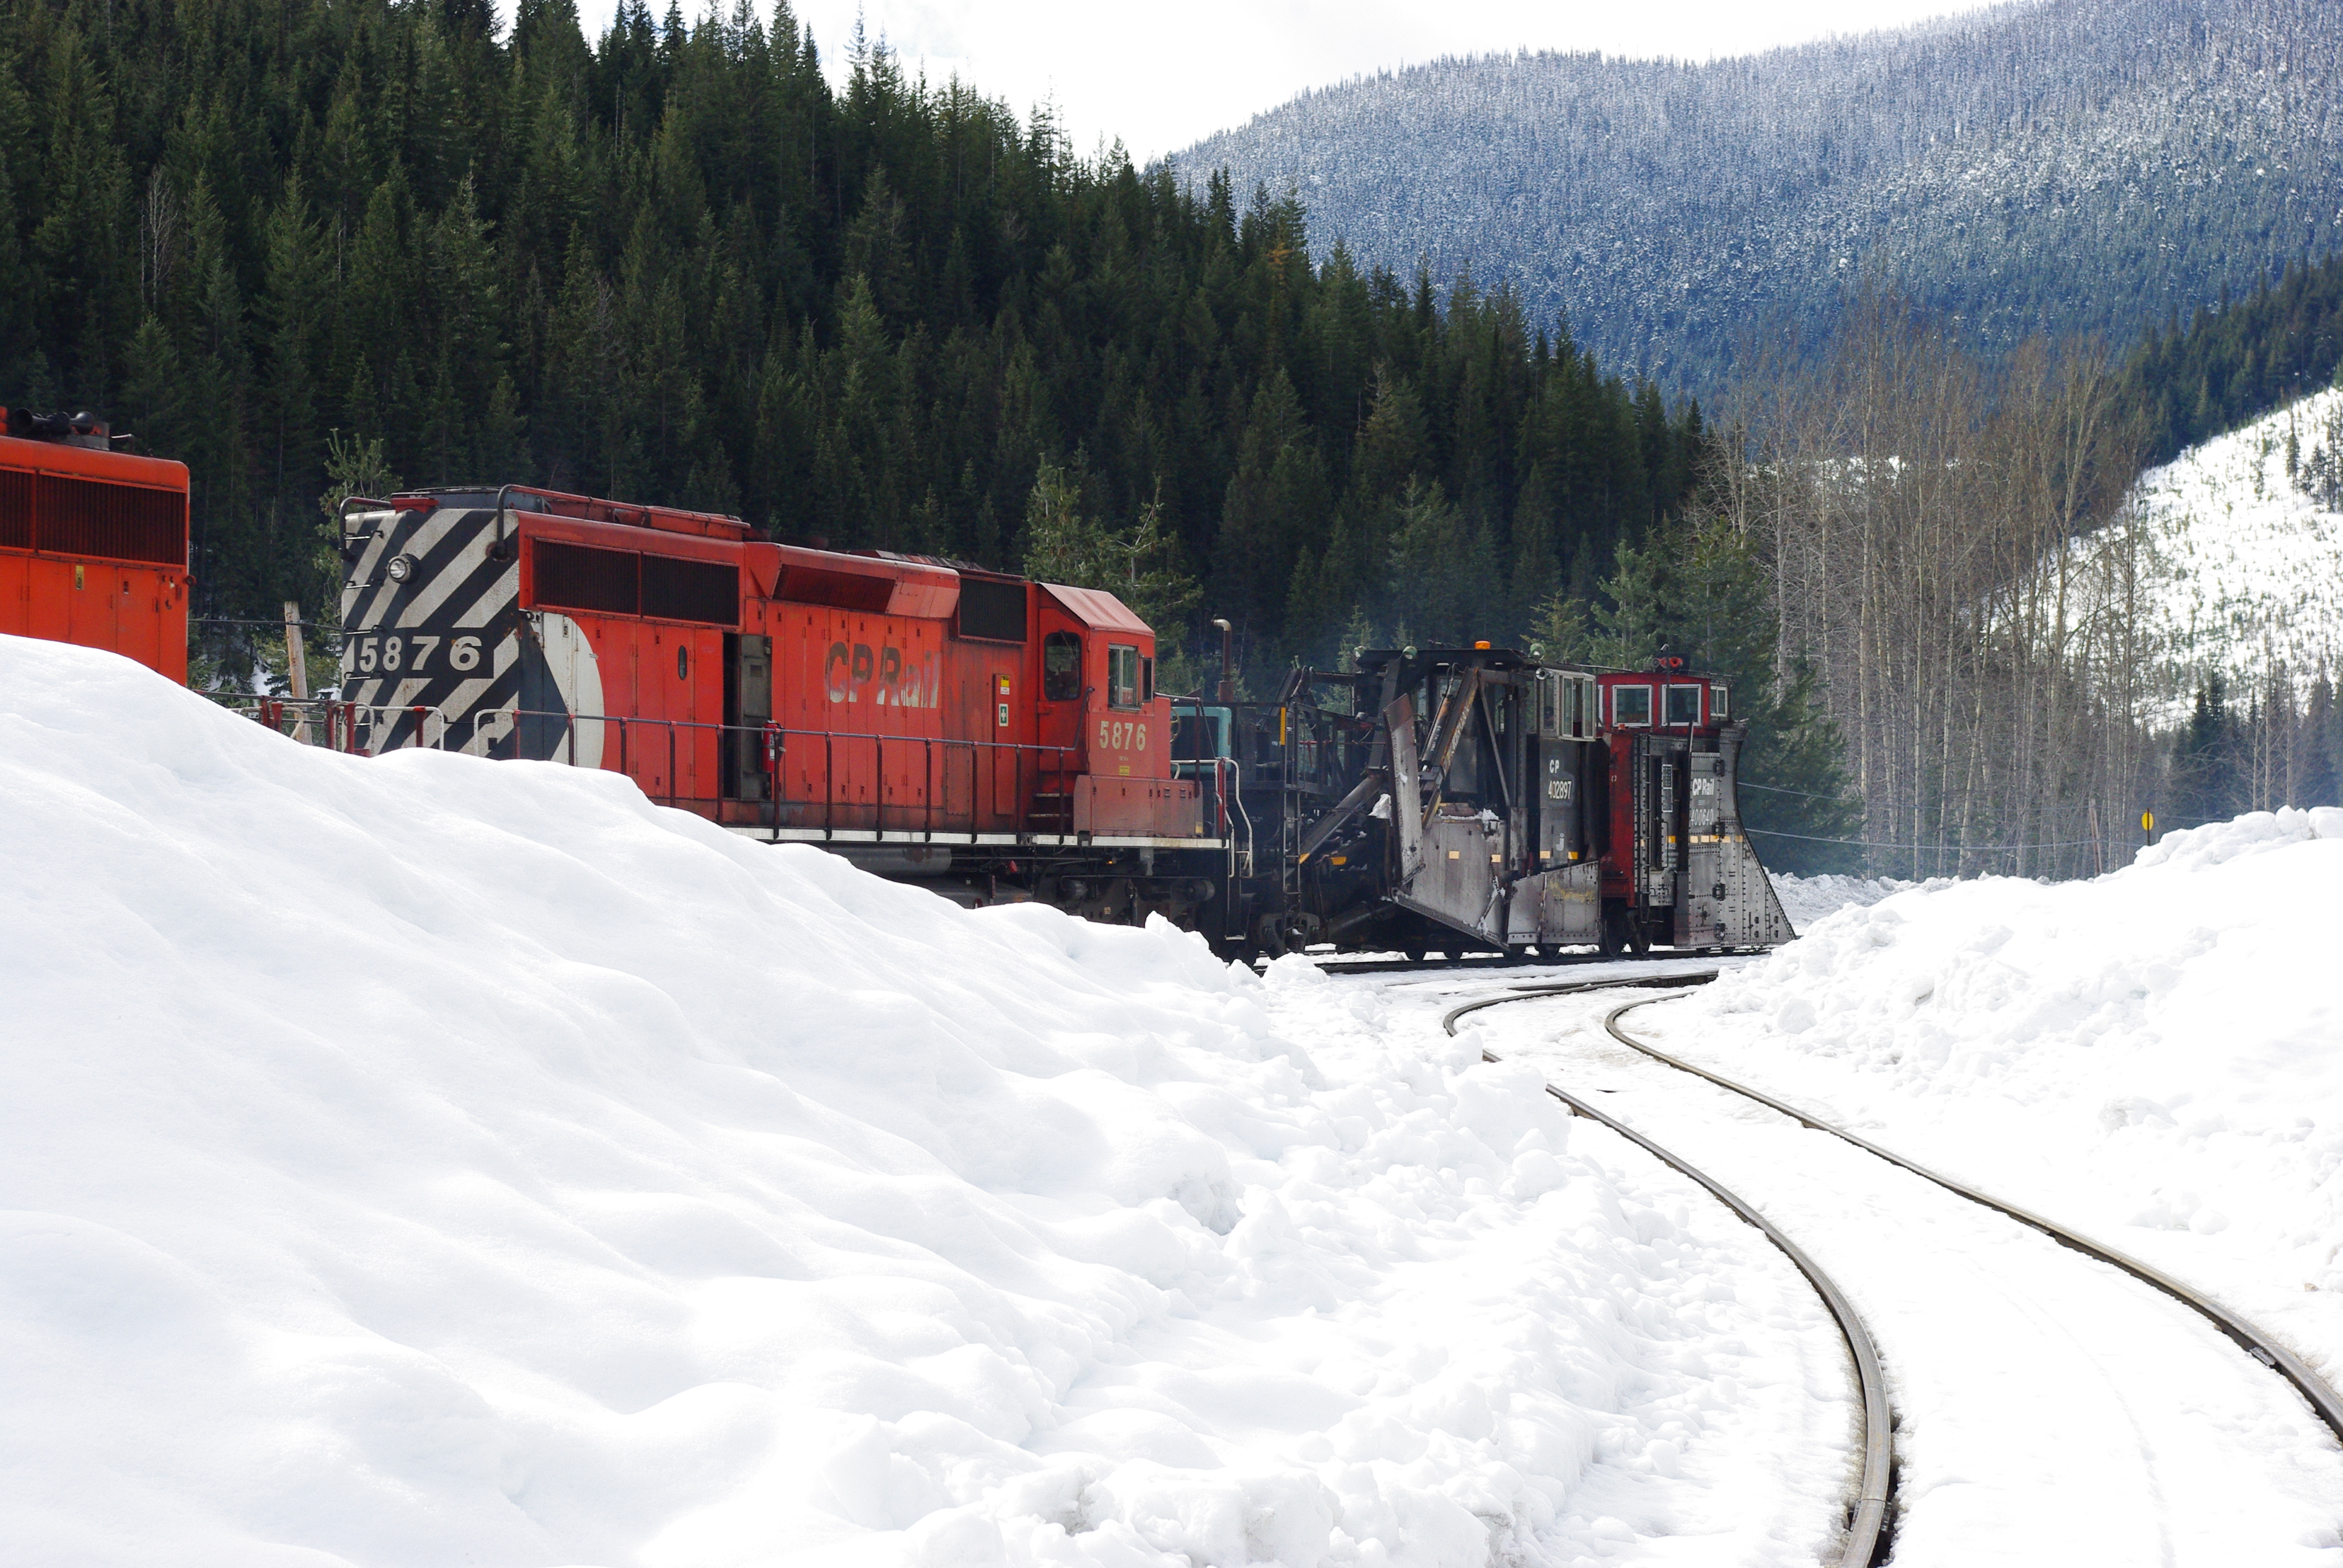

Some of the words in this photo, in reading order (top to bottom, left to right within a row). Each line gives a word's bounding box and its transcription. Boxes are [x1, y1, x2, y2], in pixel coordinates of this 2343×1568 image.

[359, 636, 483, 673] 5876
[824, 641, 874, 704] CP
[876, 646, 942, 709] Rail
[1099, 720, 1147, 751] 5876
[1549, 759, 1560, 774] CP
[1548, 780, 1572, 800] 402897
[1692, 778, 1702, 796] CP
[1702, 778, 1715, 795] Rail
[1690, 808, 1714, 826] 400640
